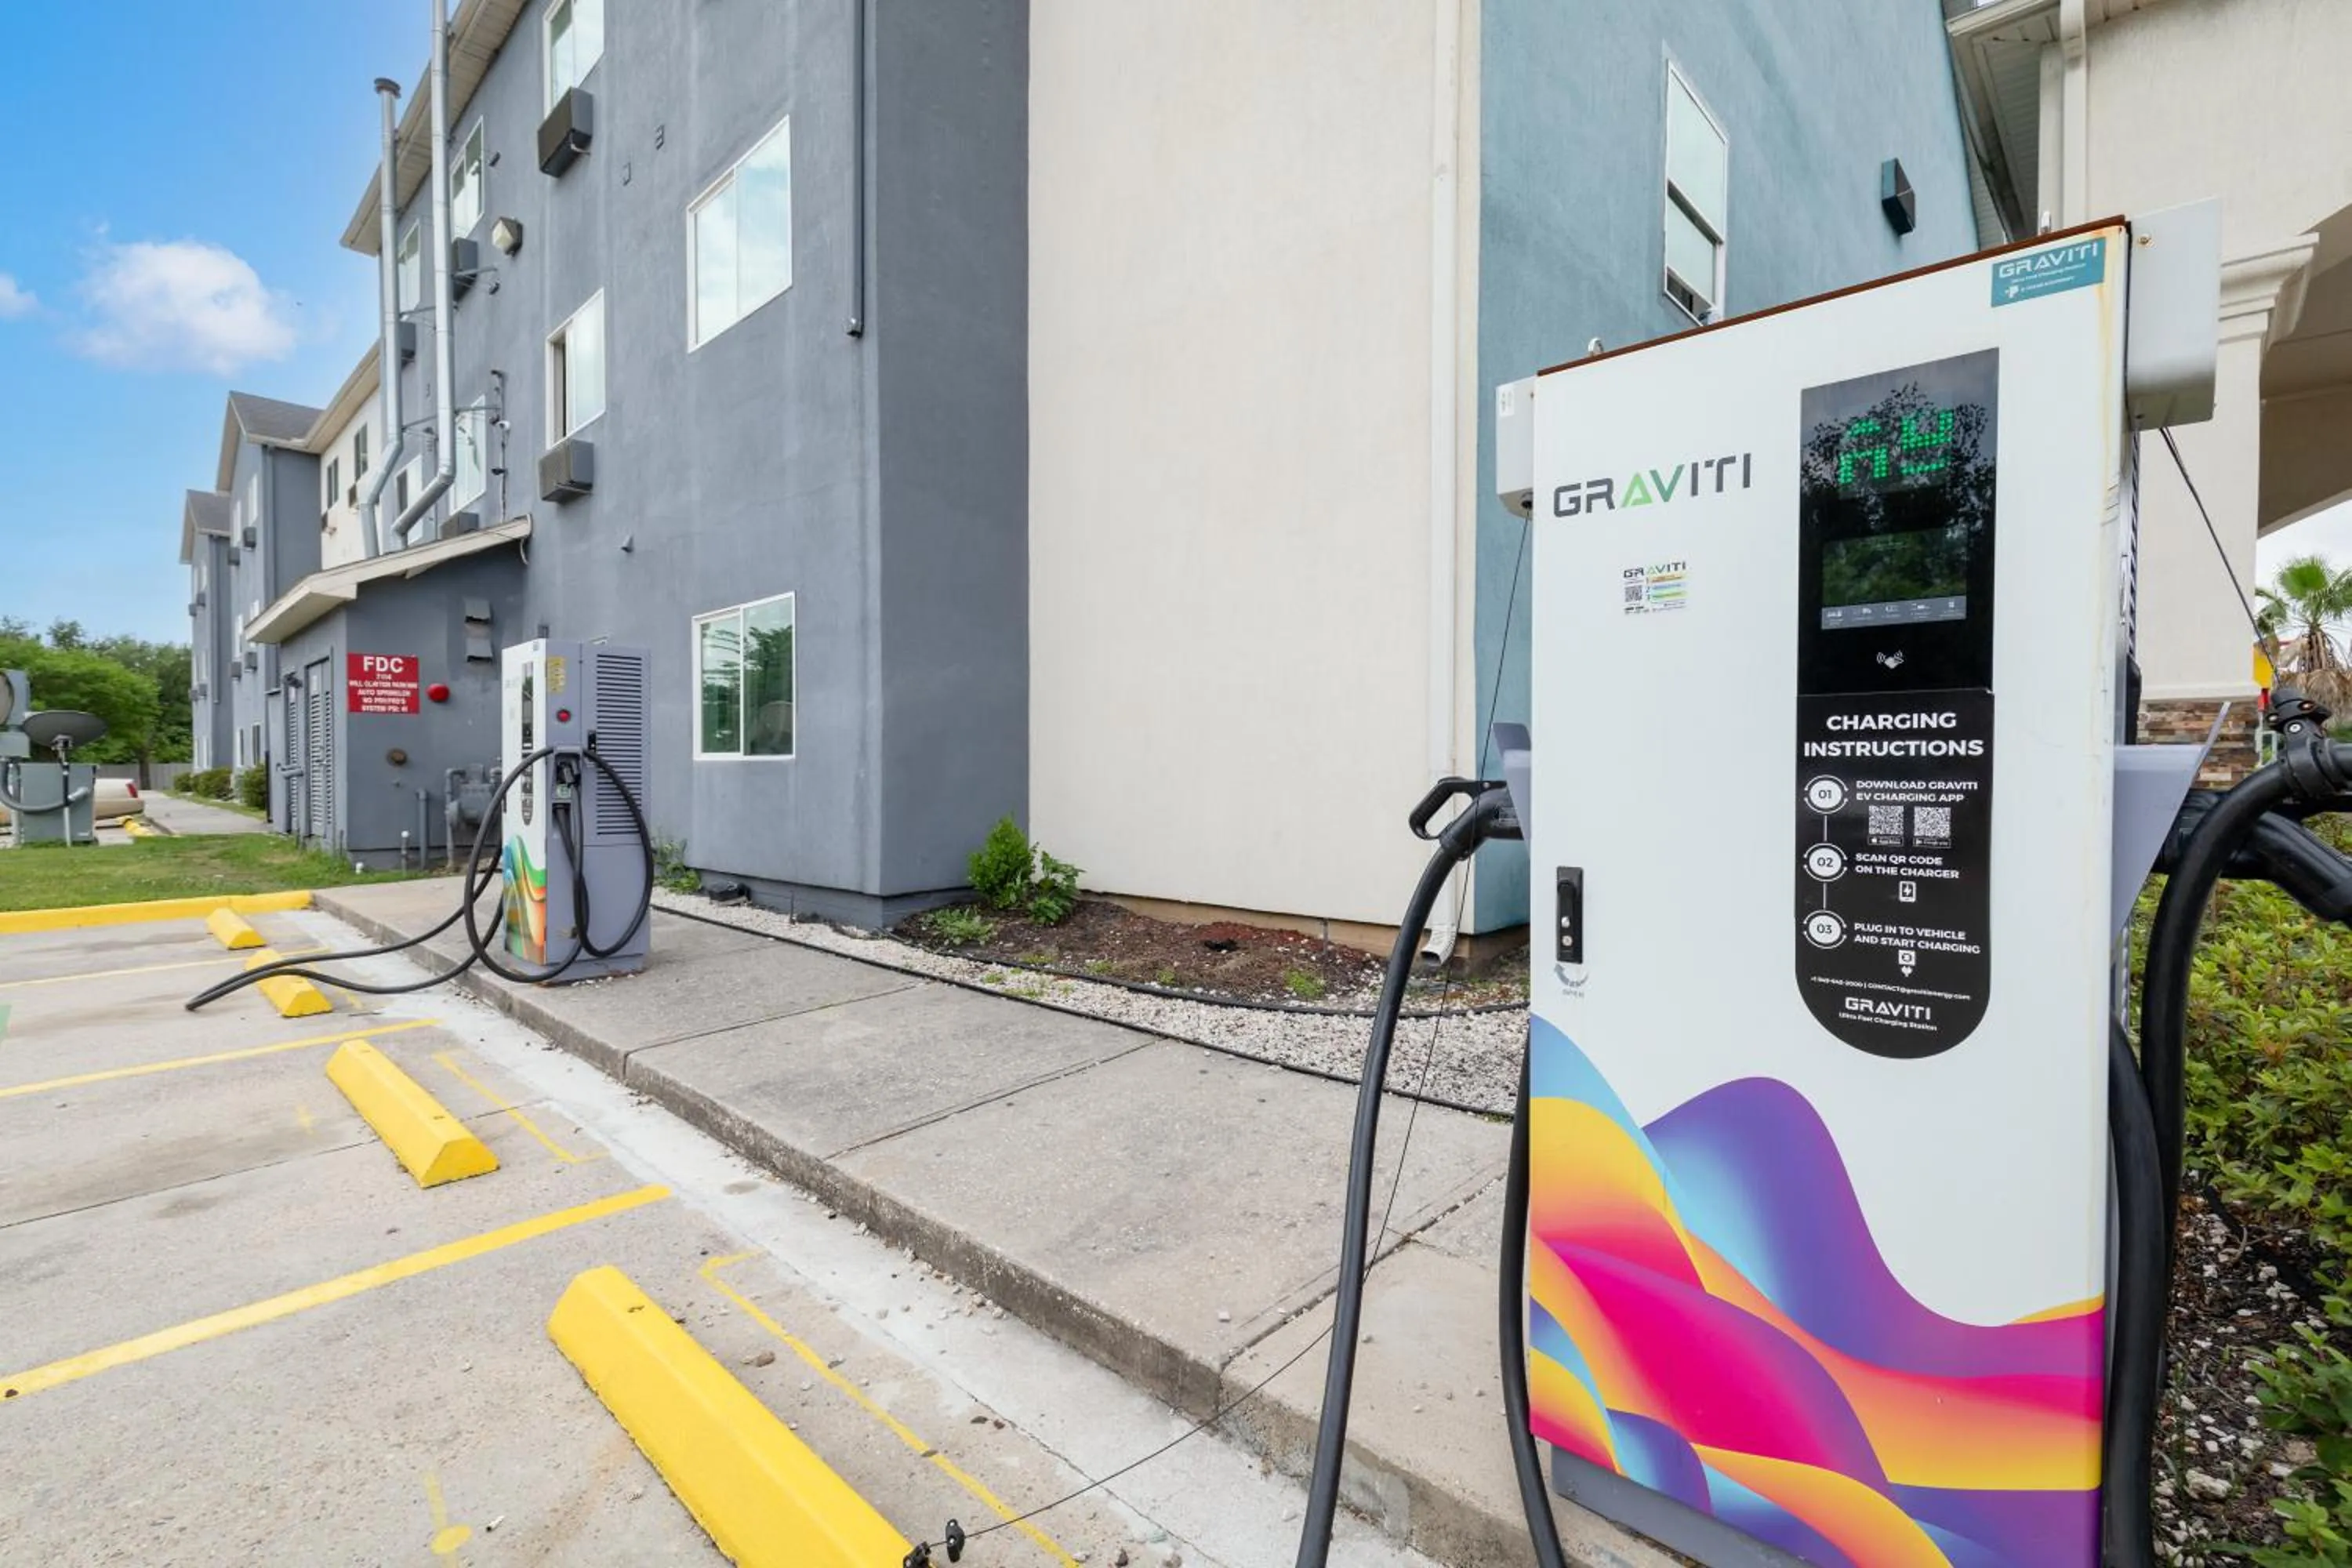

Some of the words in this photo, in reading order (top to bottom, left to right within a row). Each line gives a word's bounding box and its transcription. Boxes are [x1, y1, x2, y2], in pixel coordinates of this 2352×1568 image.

[1999, 241, 2099, 278] GRAVITI
[1553, 452, 1751, 518] GRAVITI
[1624, 561, 1686, 578] GRAVITI
[363, 656, 404, 673] FDC
[1826, 712, 1957, 731] CHARGING
[1804, 740, 1984, 757] INSTRUCTIONS
[1818, 789, 1832, 799] 01
[1856, 781, 1926, 790] DOWNLOAD
[1928, 781, 1978, 790] GRAVITI
[1856, 793, 1871, 801] EV
[1873, 793, 1936, 802] CHARGING
[1938, 793, 1965, 802] APP
[1817, 857, 1834, 867] 02
[1855, 853, 1887, 862] SCAN
[1889, 854, 1907, 865] QR
[1908, 855, 1944, 866] CODE
[1855, 866, 1874, 874] ON
[1875, 866, 1898, 876] THE
[1900, 867, 1960, 878] CHARGER
[1817, 924, 1833, 935] 03
[1854, 923, 1883, 933] PLUG
[1884, 924, 1897, 934] IN
[1898, 926, 1915, 935] TO
[1915, 927, 1966, 940] VEHICLE
[1854, 935, 1879, 944] AND
[1881, 937, 1916, 947] START
[1917, 940, 1981, 954] CHARGING
[1844, 996, 1931, 1020] GRAVITI
[1857, 1014, 1873, 1022] Fast
[1874, 1016, 1908, 1029] Charging
